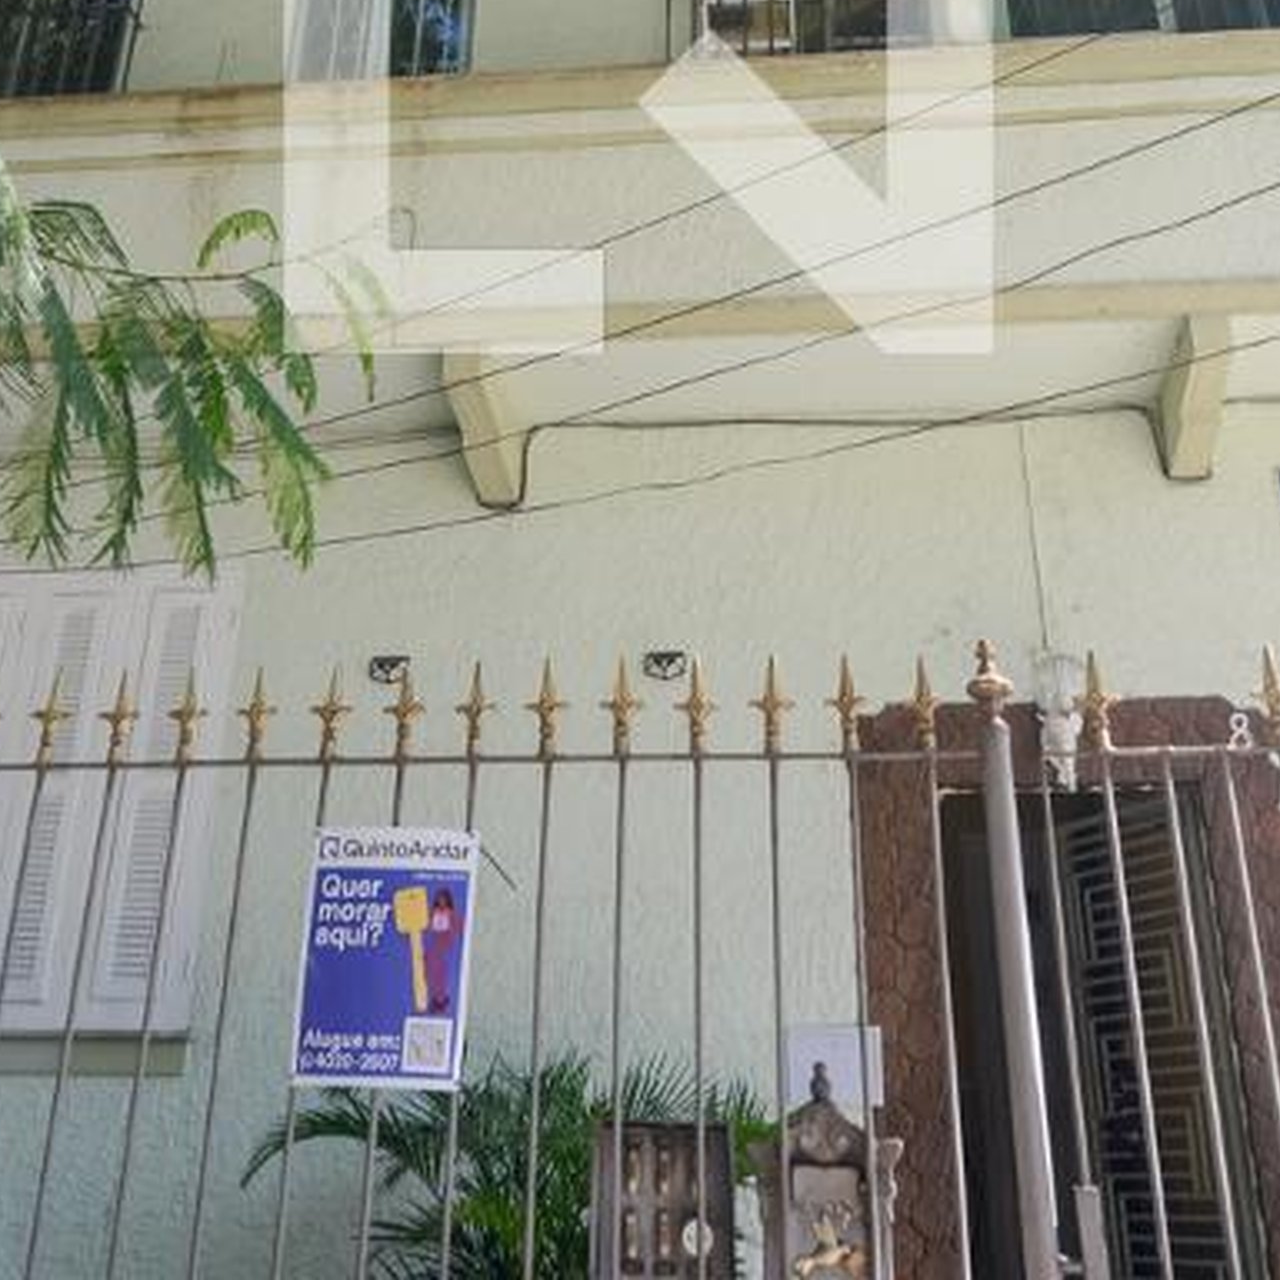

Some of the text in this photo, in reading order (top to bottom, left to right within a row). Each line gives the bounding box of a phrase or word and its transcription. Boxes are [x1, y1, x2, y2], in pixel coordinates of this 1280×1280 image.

[343, 836, 470, 860] QuintoAndar
[321, 873, 384, 899] Quer
[318, 901, 391, 923] morar
[315, 924, 384, 951] aqui?
